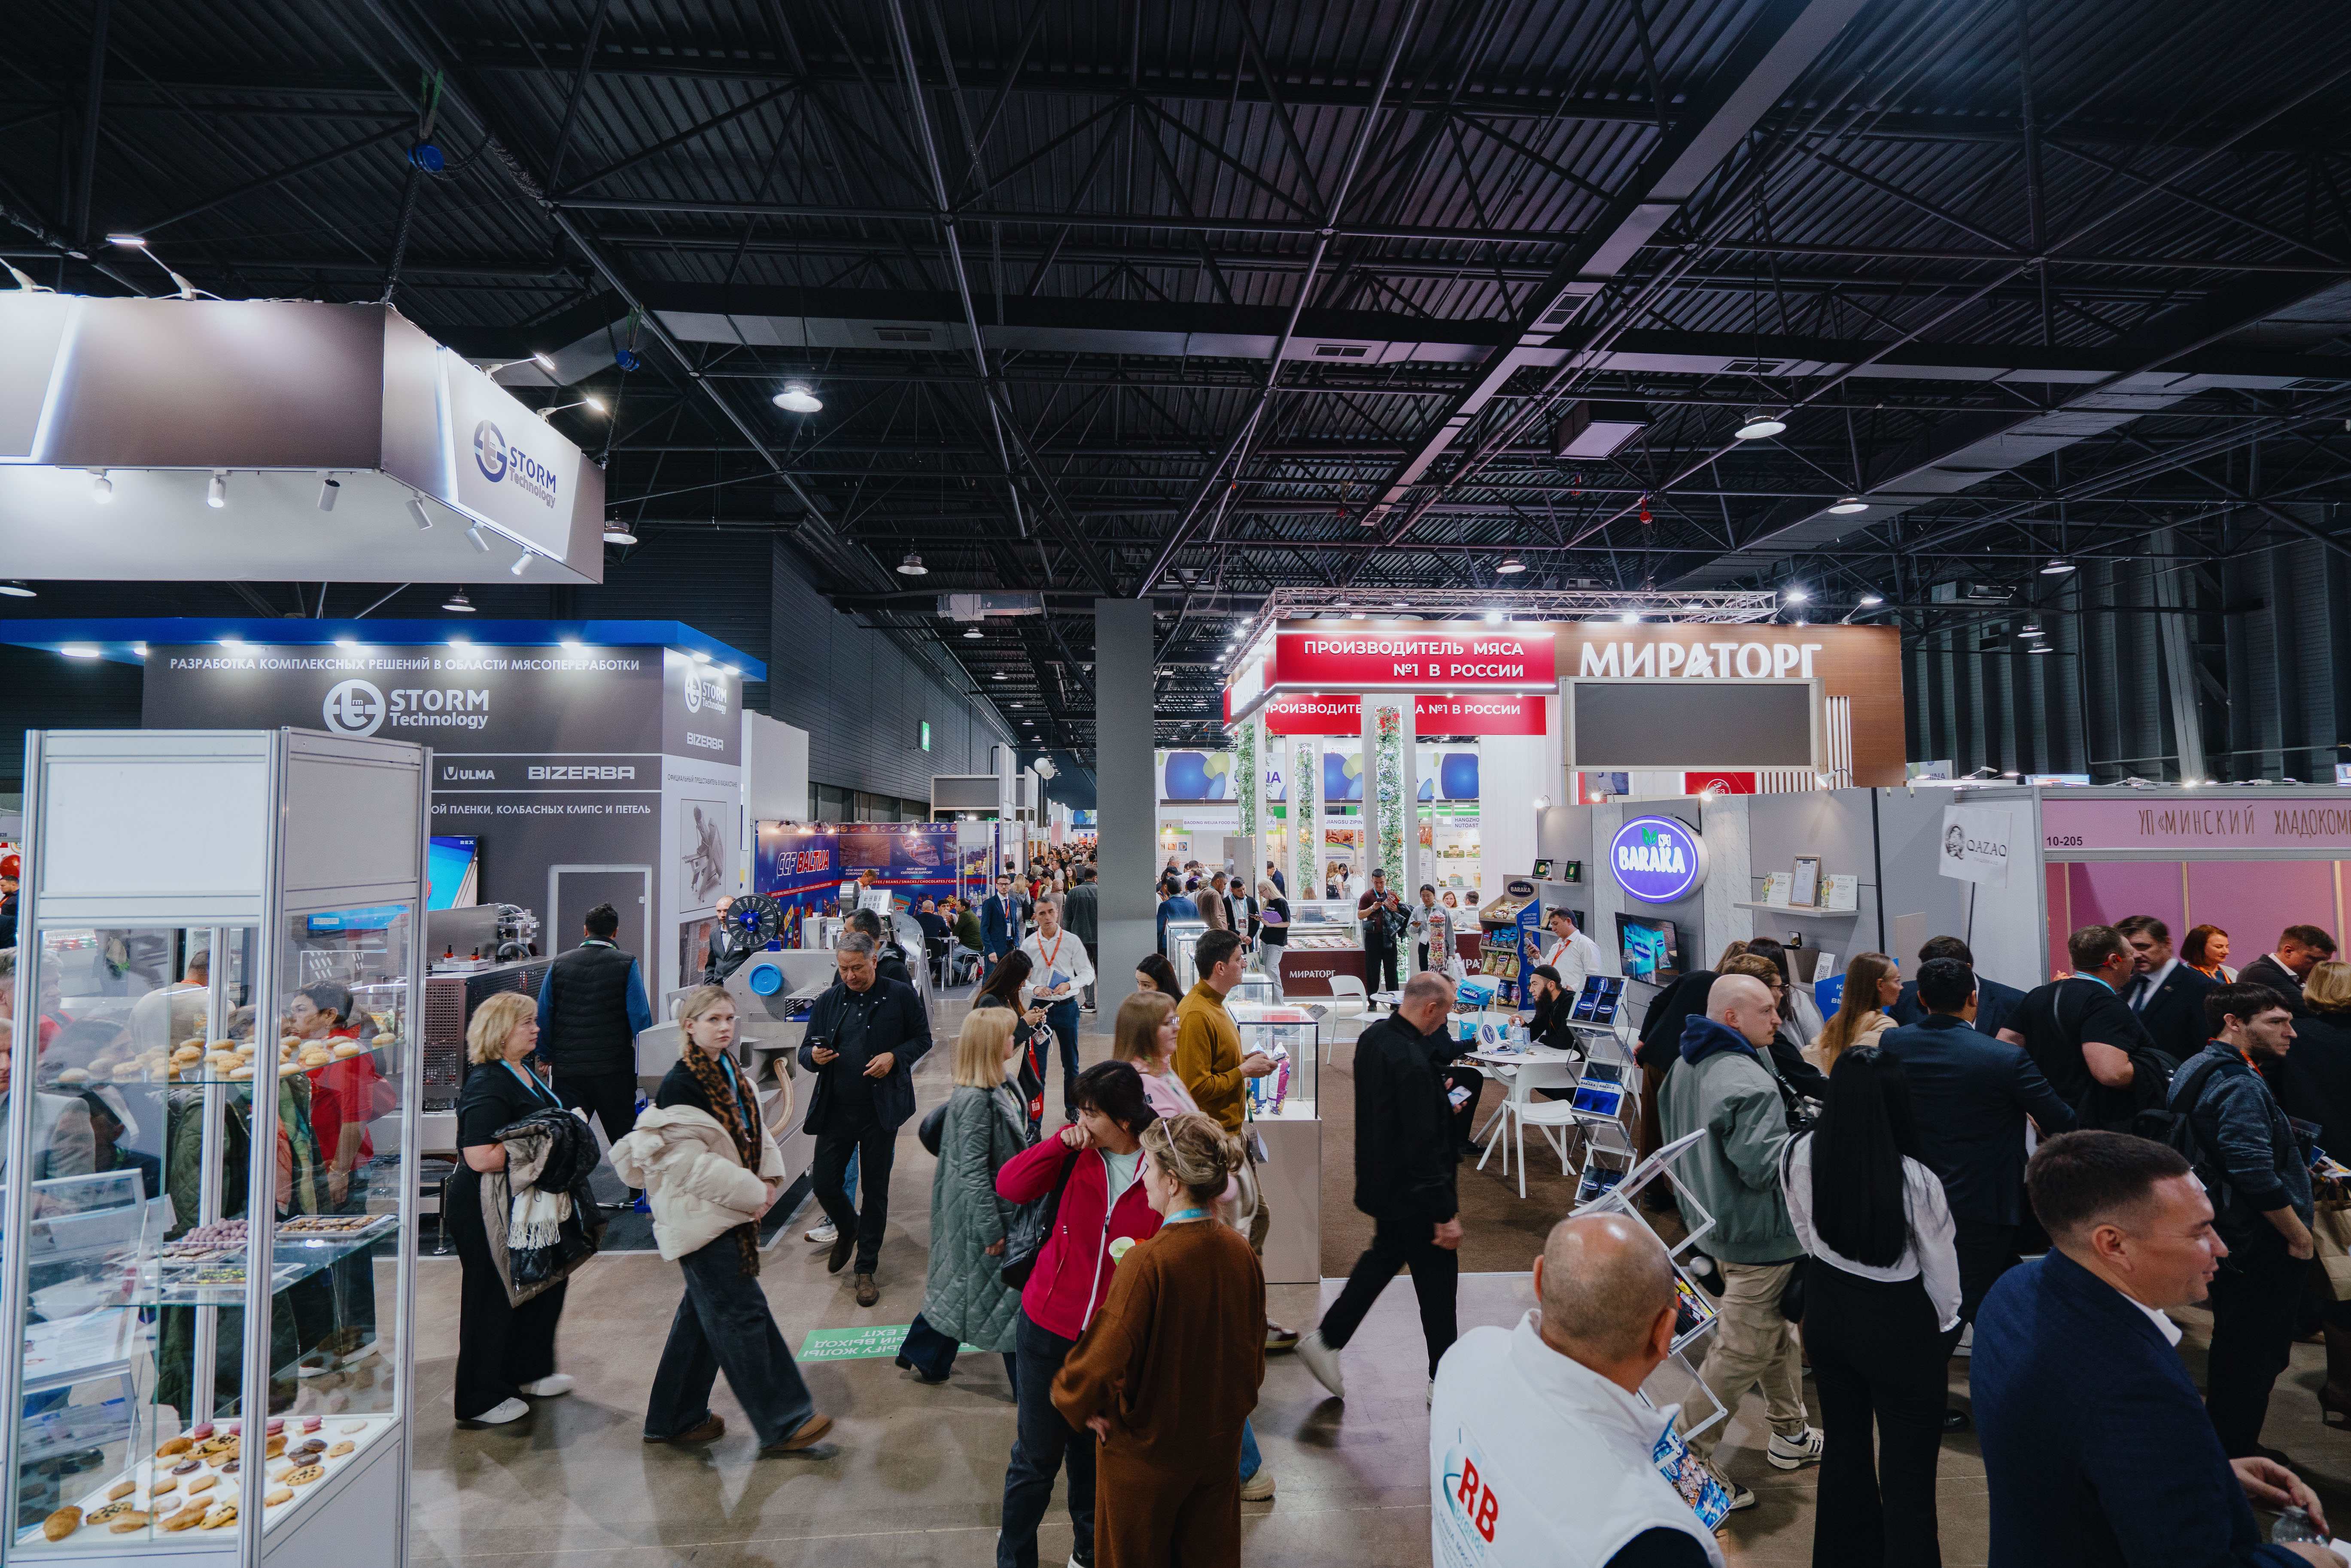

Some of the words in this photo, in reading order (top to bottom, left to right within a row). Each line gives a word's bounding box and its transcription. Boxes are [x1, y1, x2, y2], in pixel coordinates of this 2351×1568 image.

[510, 447, 556, 493] STORM
[509, 466, 556, 509] Technology
[1304, 641, 1464, 656] ПРОИЗВОДИТЕЛЬ
[1474, 642, 1524, 656] МЯСА
[170, 658, 255, 669] РАЗРАБОТКА
[259, 659, 365, 670] КОМПЛЕКСНЫХ
[368, 657, 430, 670] РЕШЕНИЙ
[434, 659, 442, 670] В
[445, 659, 508, 670] ОБЛАСТИ
[511, 659, 639, 671] МЯСОПЕРЕРАБОТКИ
[1580, 642, 1822, 678] МИРАТОРГ
[1394, 663, 1418, 677] №1
[1429, 664, 1440, 677] В
[1451, 664, 1524, 678] РОССИИ
[702, 681, 727, 703] STORM
[390, 689, 489, 711] STORM
[702, 696, 727, 715] Technology
[1266, 703, 1361, 715] РОИЗВОДИТЕ
[1429, 704, 1448, 714] №1
[1452, 704, 1460, 714] В
[1465, 705, 1521, 714] РОССИИ
[389, 711, 489, 729] Technology
[687, 732, 724, 751] BIZERBA
[459, 770, 495, 780] ULMA
[528, 766, 635, 780] BIZERBA
[667, 774, 694, 783] ОФИЦИАЛЬНЫЙ
[450, 805, 493, 815] ПЛЕНКИ,
[496, 805, 565, 814] КОЛБАСНЫХ
[567, 805, 602, 814] КЛИПС
[605, 805, 613, 814] И
[616, 805, 651, 814] ПЕТЕЛЬ
[2138, 810, 2154, 835] УП
[1966, 839, 2007, 857] QAZAQ
[2047, 836, 2083, 847] 10-205
[777, 852, 797, 876] CCF
[797, 850, 829, 874] BALTIJA
[1618, 846, 1686, 874] BARAKA
[1290, 970, 1336, 978] МИРАТОРГ
[1462, 989, 1478, 998] BARAKA
[861, 1328, 897, 1337] EXIT
[815, 1338, 875, 1348] ВЫХОД
[863, 1344, 901, 1354] ЫҒУ
[804, 1347, 859, 1357] ЖОЛЫ
[1458, 1456, 1499, 1544] RB
